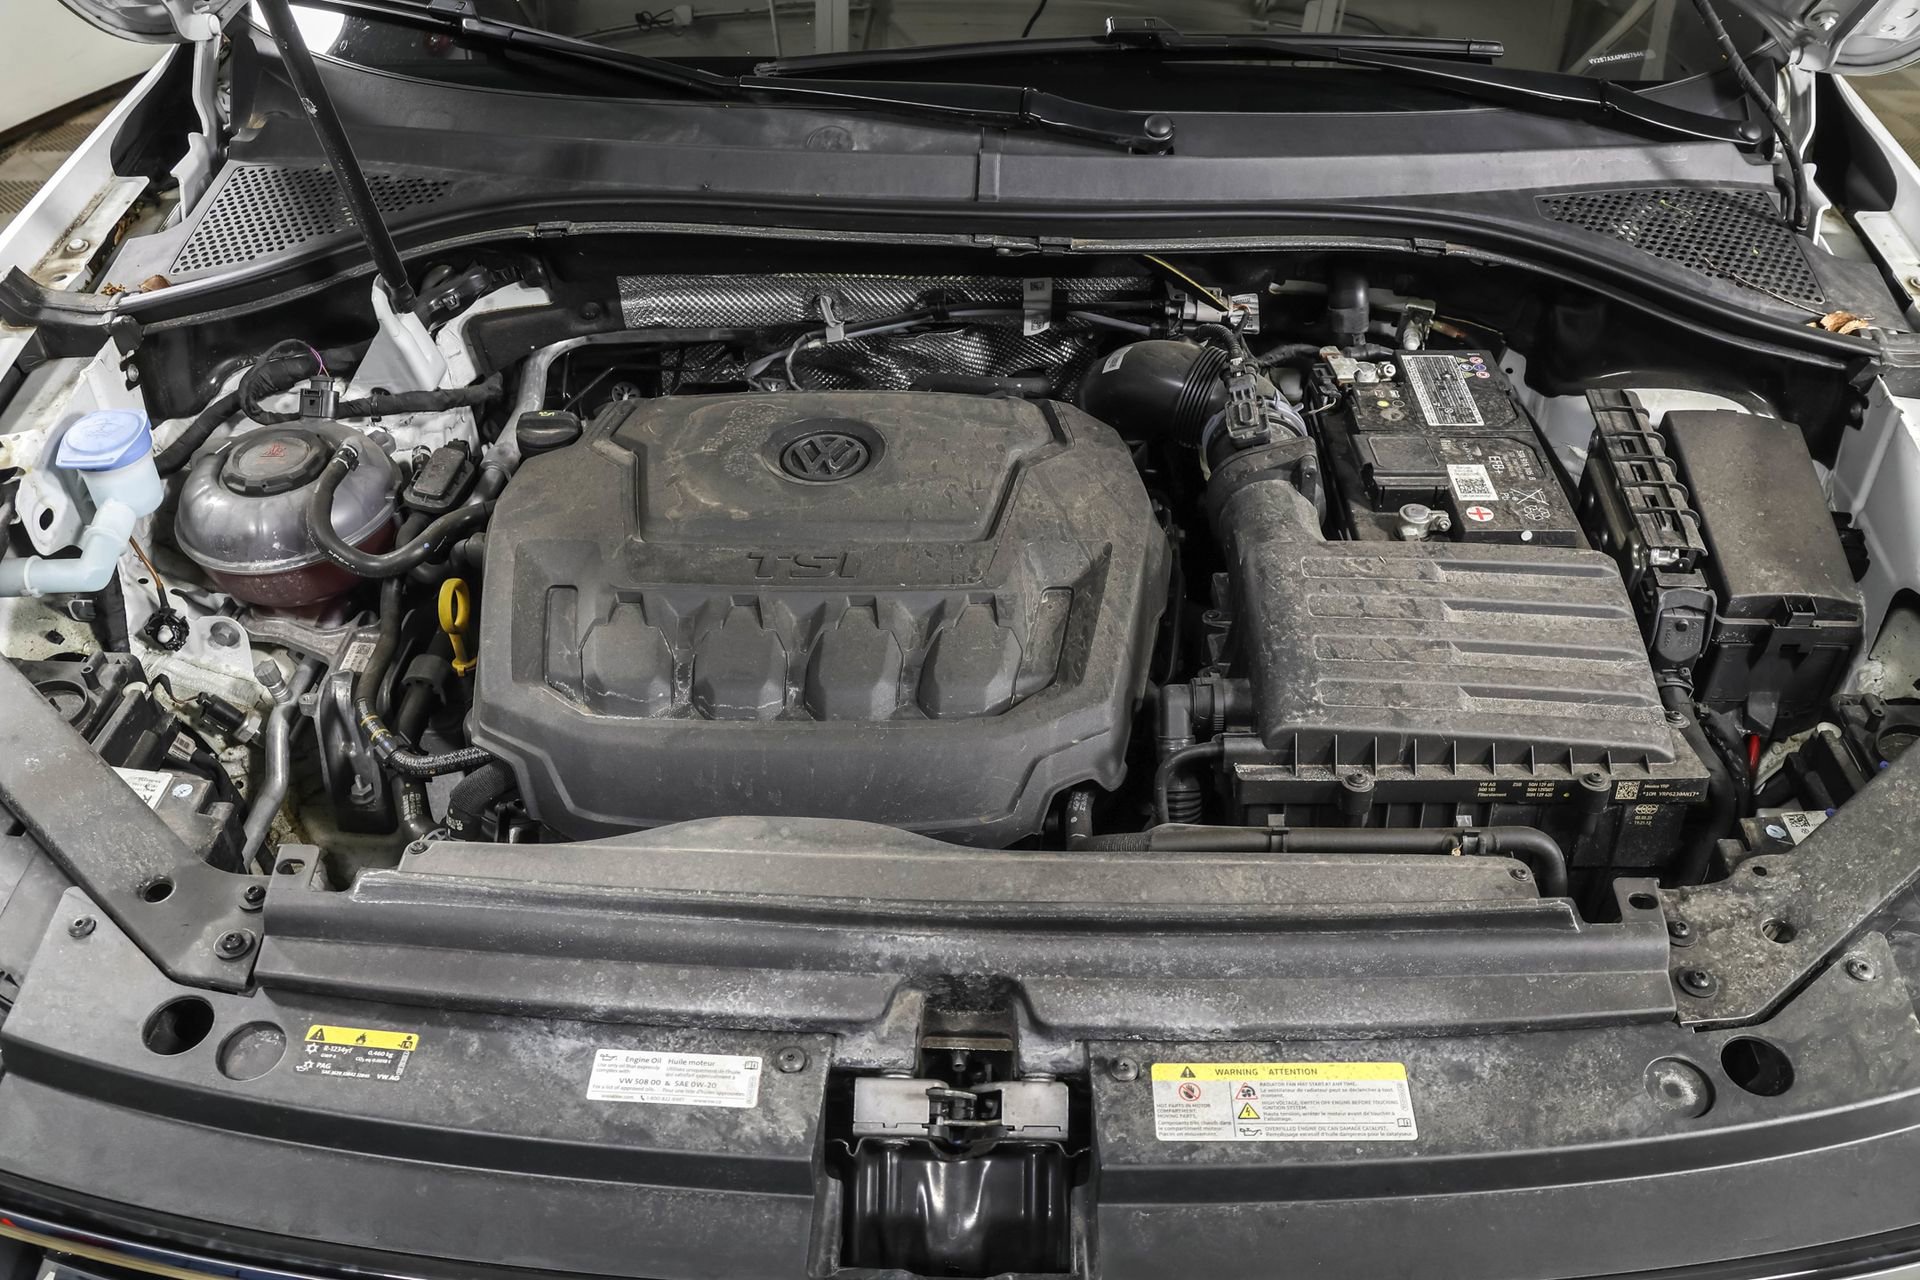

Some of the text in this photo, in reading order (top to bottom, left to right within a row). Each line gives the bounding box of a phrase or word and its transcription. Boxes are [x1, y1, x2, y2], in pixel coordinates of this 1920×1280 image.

[1488, 455, 1505, 474] EFB+
[748, 552, 858, 579] TSI
[625, 1056, 650, 1064] Engine
